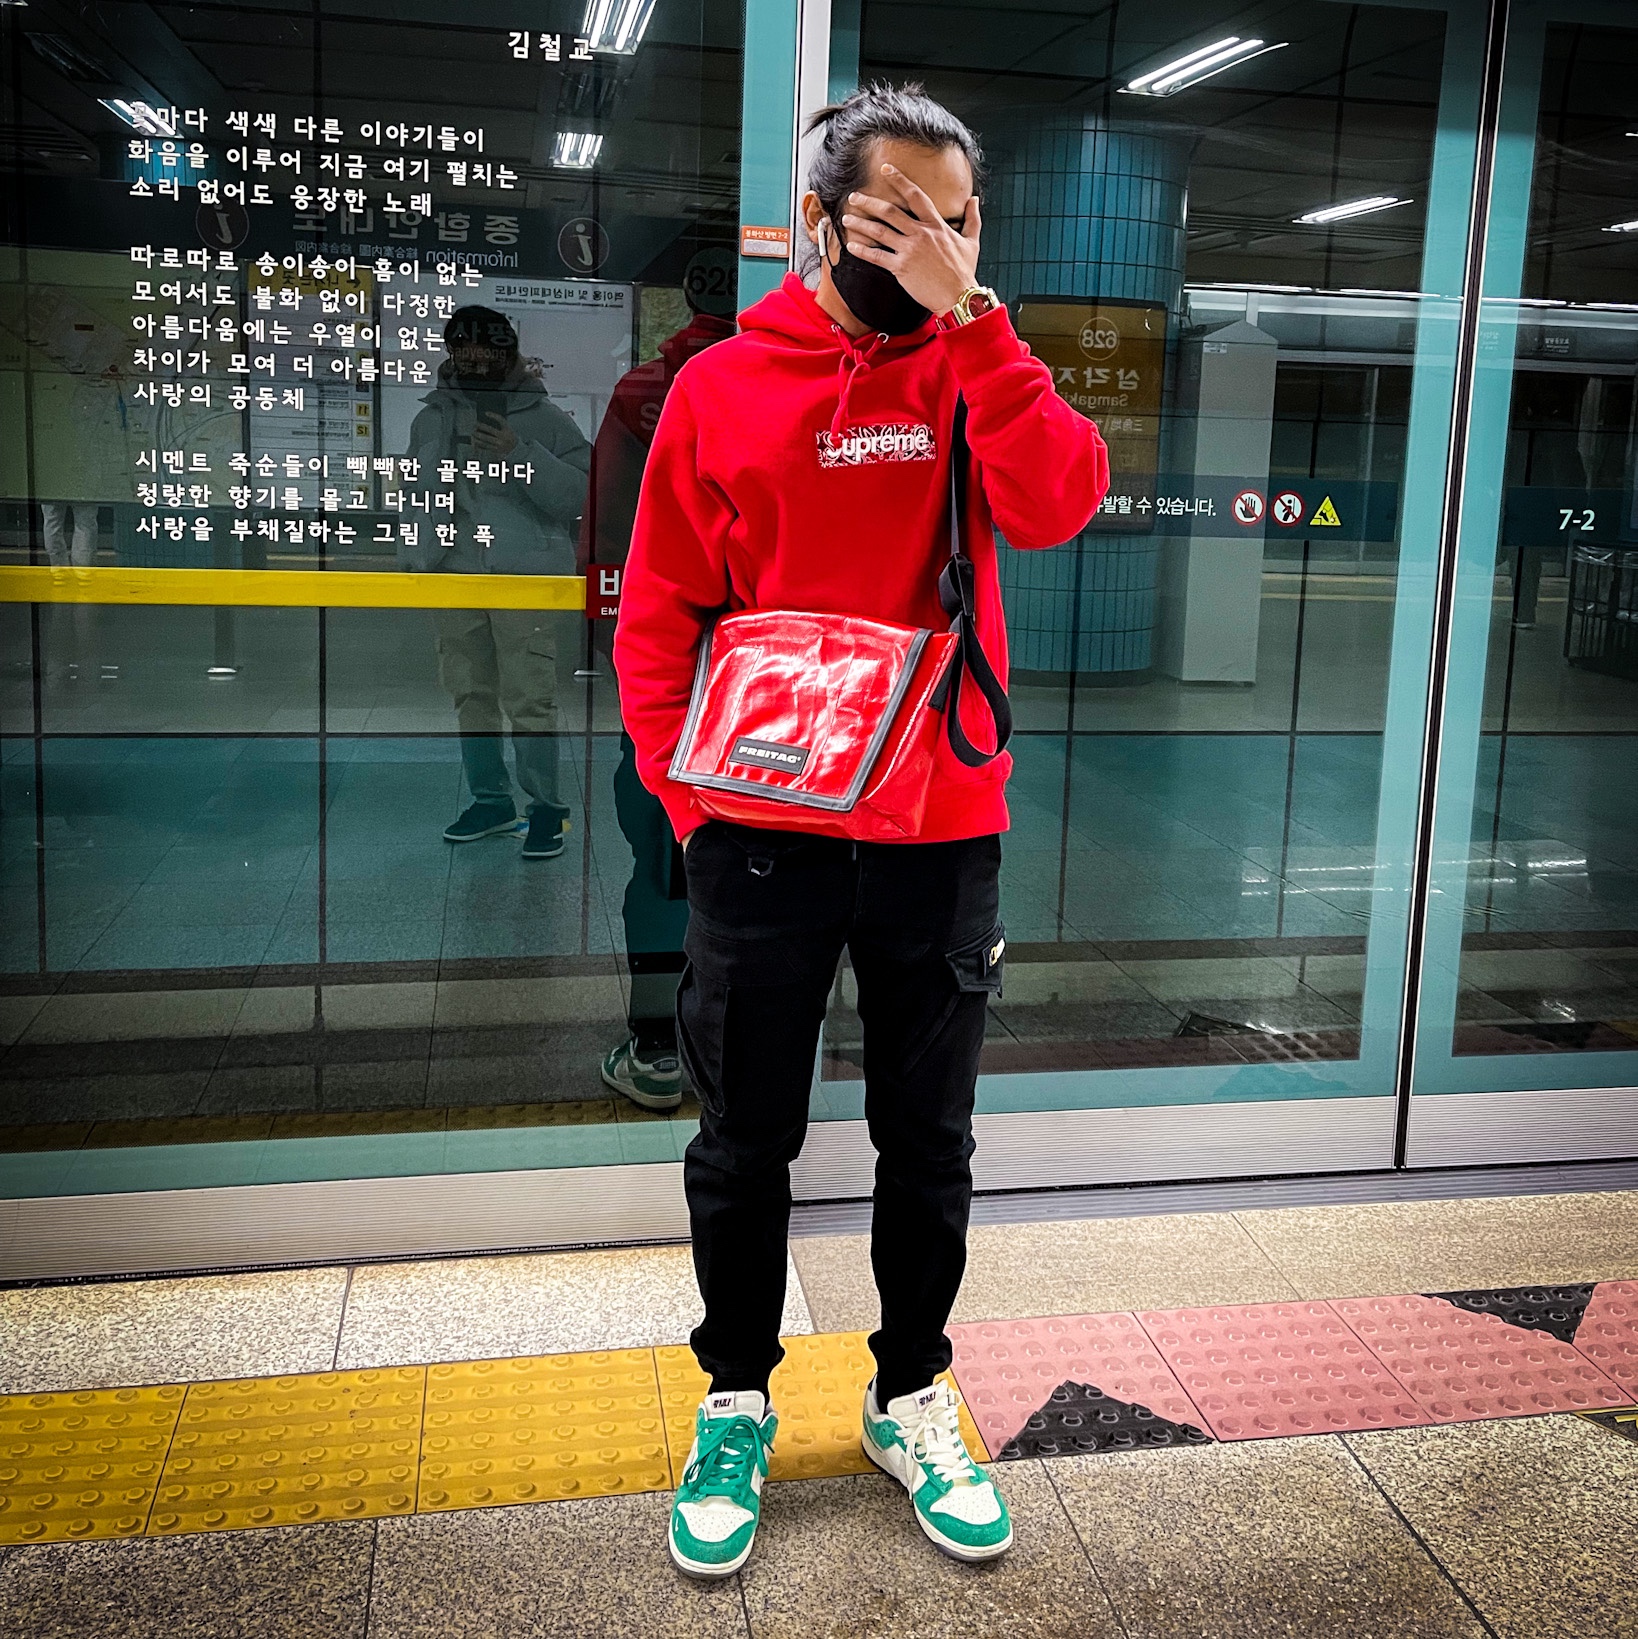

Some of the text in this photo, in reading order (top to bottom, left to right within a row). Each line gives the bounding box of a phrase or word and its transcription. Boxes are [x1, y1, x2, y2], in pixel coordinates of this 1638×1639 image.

[225, 111, 276, 139] 색색
[294, 116, 344, 144] 다른
[360, 120, 484, 153] 이야기들이
[128, 139, 518, 189] 화음을 이루어 지금 여기 펼치는
[129, 176, 432, 217] 소리 없어도 웅장한 노래
[130, 244, 484, 288] 따로따로 송이송이 흠이 없는
[131, 280, 456, 319] 모여서도 불화 없이 다정한
[132, 313, 446, 352] 아름다움에는 우열이 없는
[133, 347, 211, 375] 차이가
[227, 353, 276, 377] 모여
[293, 354, 313, 380] 더
[330, 356, 432, 385] 아름다운
[133, 381, 304, 412] 사랑의 공동체
[135, 449, 536, 485] 시멘트 죽순들이 빽빽한 골목마다
[136, 482, 455, 514] 청량한 향기를 몰고 다니며
[1136, 496, 1153, 515] 수
[1155, 496, 1217, 517] 있습니다.
[135, 515, 496, 548] 사랑을 부채질하는 그림 한 폭
[1558, 507, 1596, 531] 7-2
